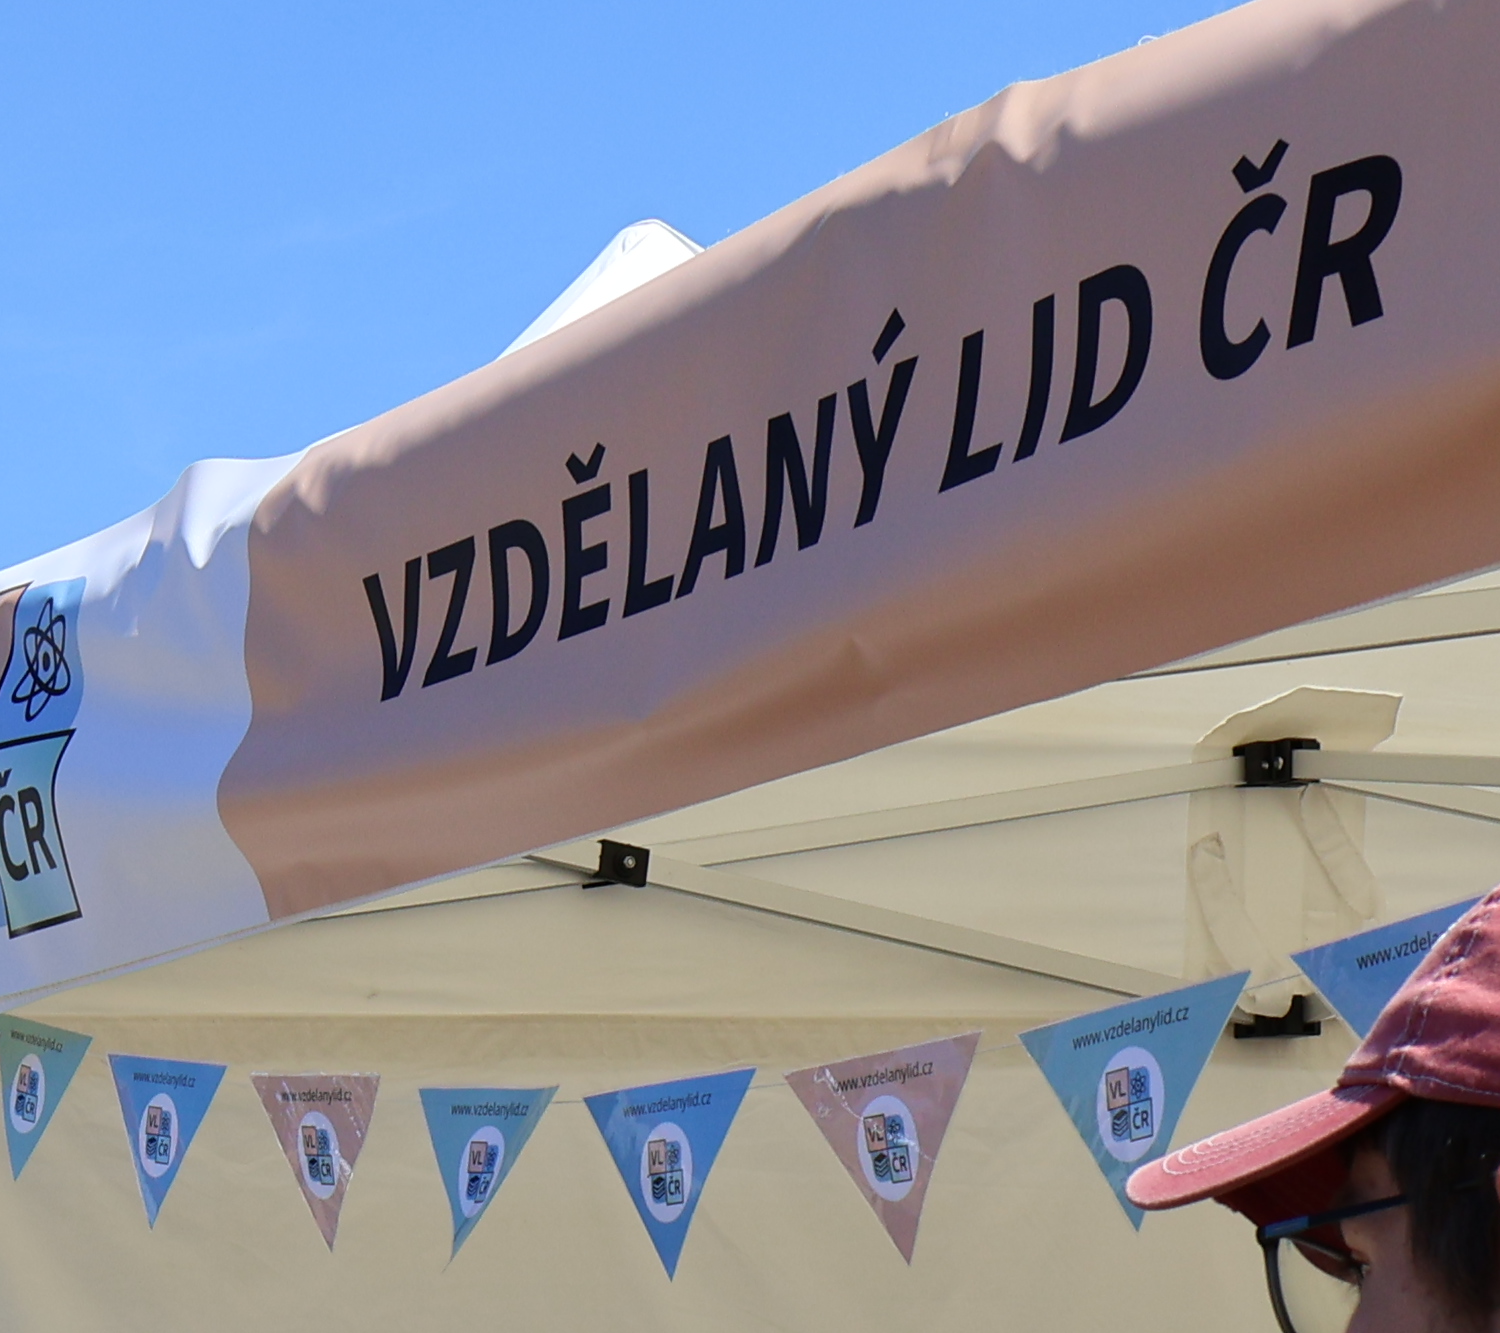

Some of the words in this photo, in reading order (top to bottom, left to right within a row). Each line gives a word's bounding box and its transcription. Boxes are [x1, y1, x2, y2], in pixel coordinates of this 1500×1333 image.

[362, 307, 918, 702] VZDĚLANÝ
[938, 263, 1154, 493] LID
[1199, 137, 1403, 381] ČR
[1072, 1005, 1190, 1050] www.vzdelanylid.cz
[132, 1070, 196, 1089] www.vzdelanylid.cz
[832, 1062, 934, 1094] www.vzdelanylid.cz
[1108, 1080, 1127, 1099] VL
[450, 1102, 530, 1119] www.vzdelanylid.cz
[622, 1091, 712, 1118] www.vzdelanylid.cz
[148, 1111, 160, 1129] VL
[1132, 1103, 1151, 1130] ČR
[157, 1135, 170, 1157] ČR
[650, 1147, 664, 1166] VL
[471, 1149, 485, 1167] VL
[889, 1147, 910, 1177] ČR
[666, 1171, 683, 1196] ČR
